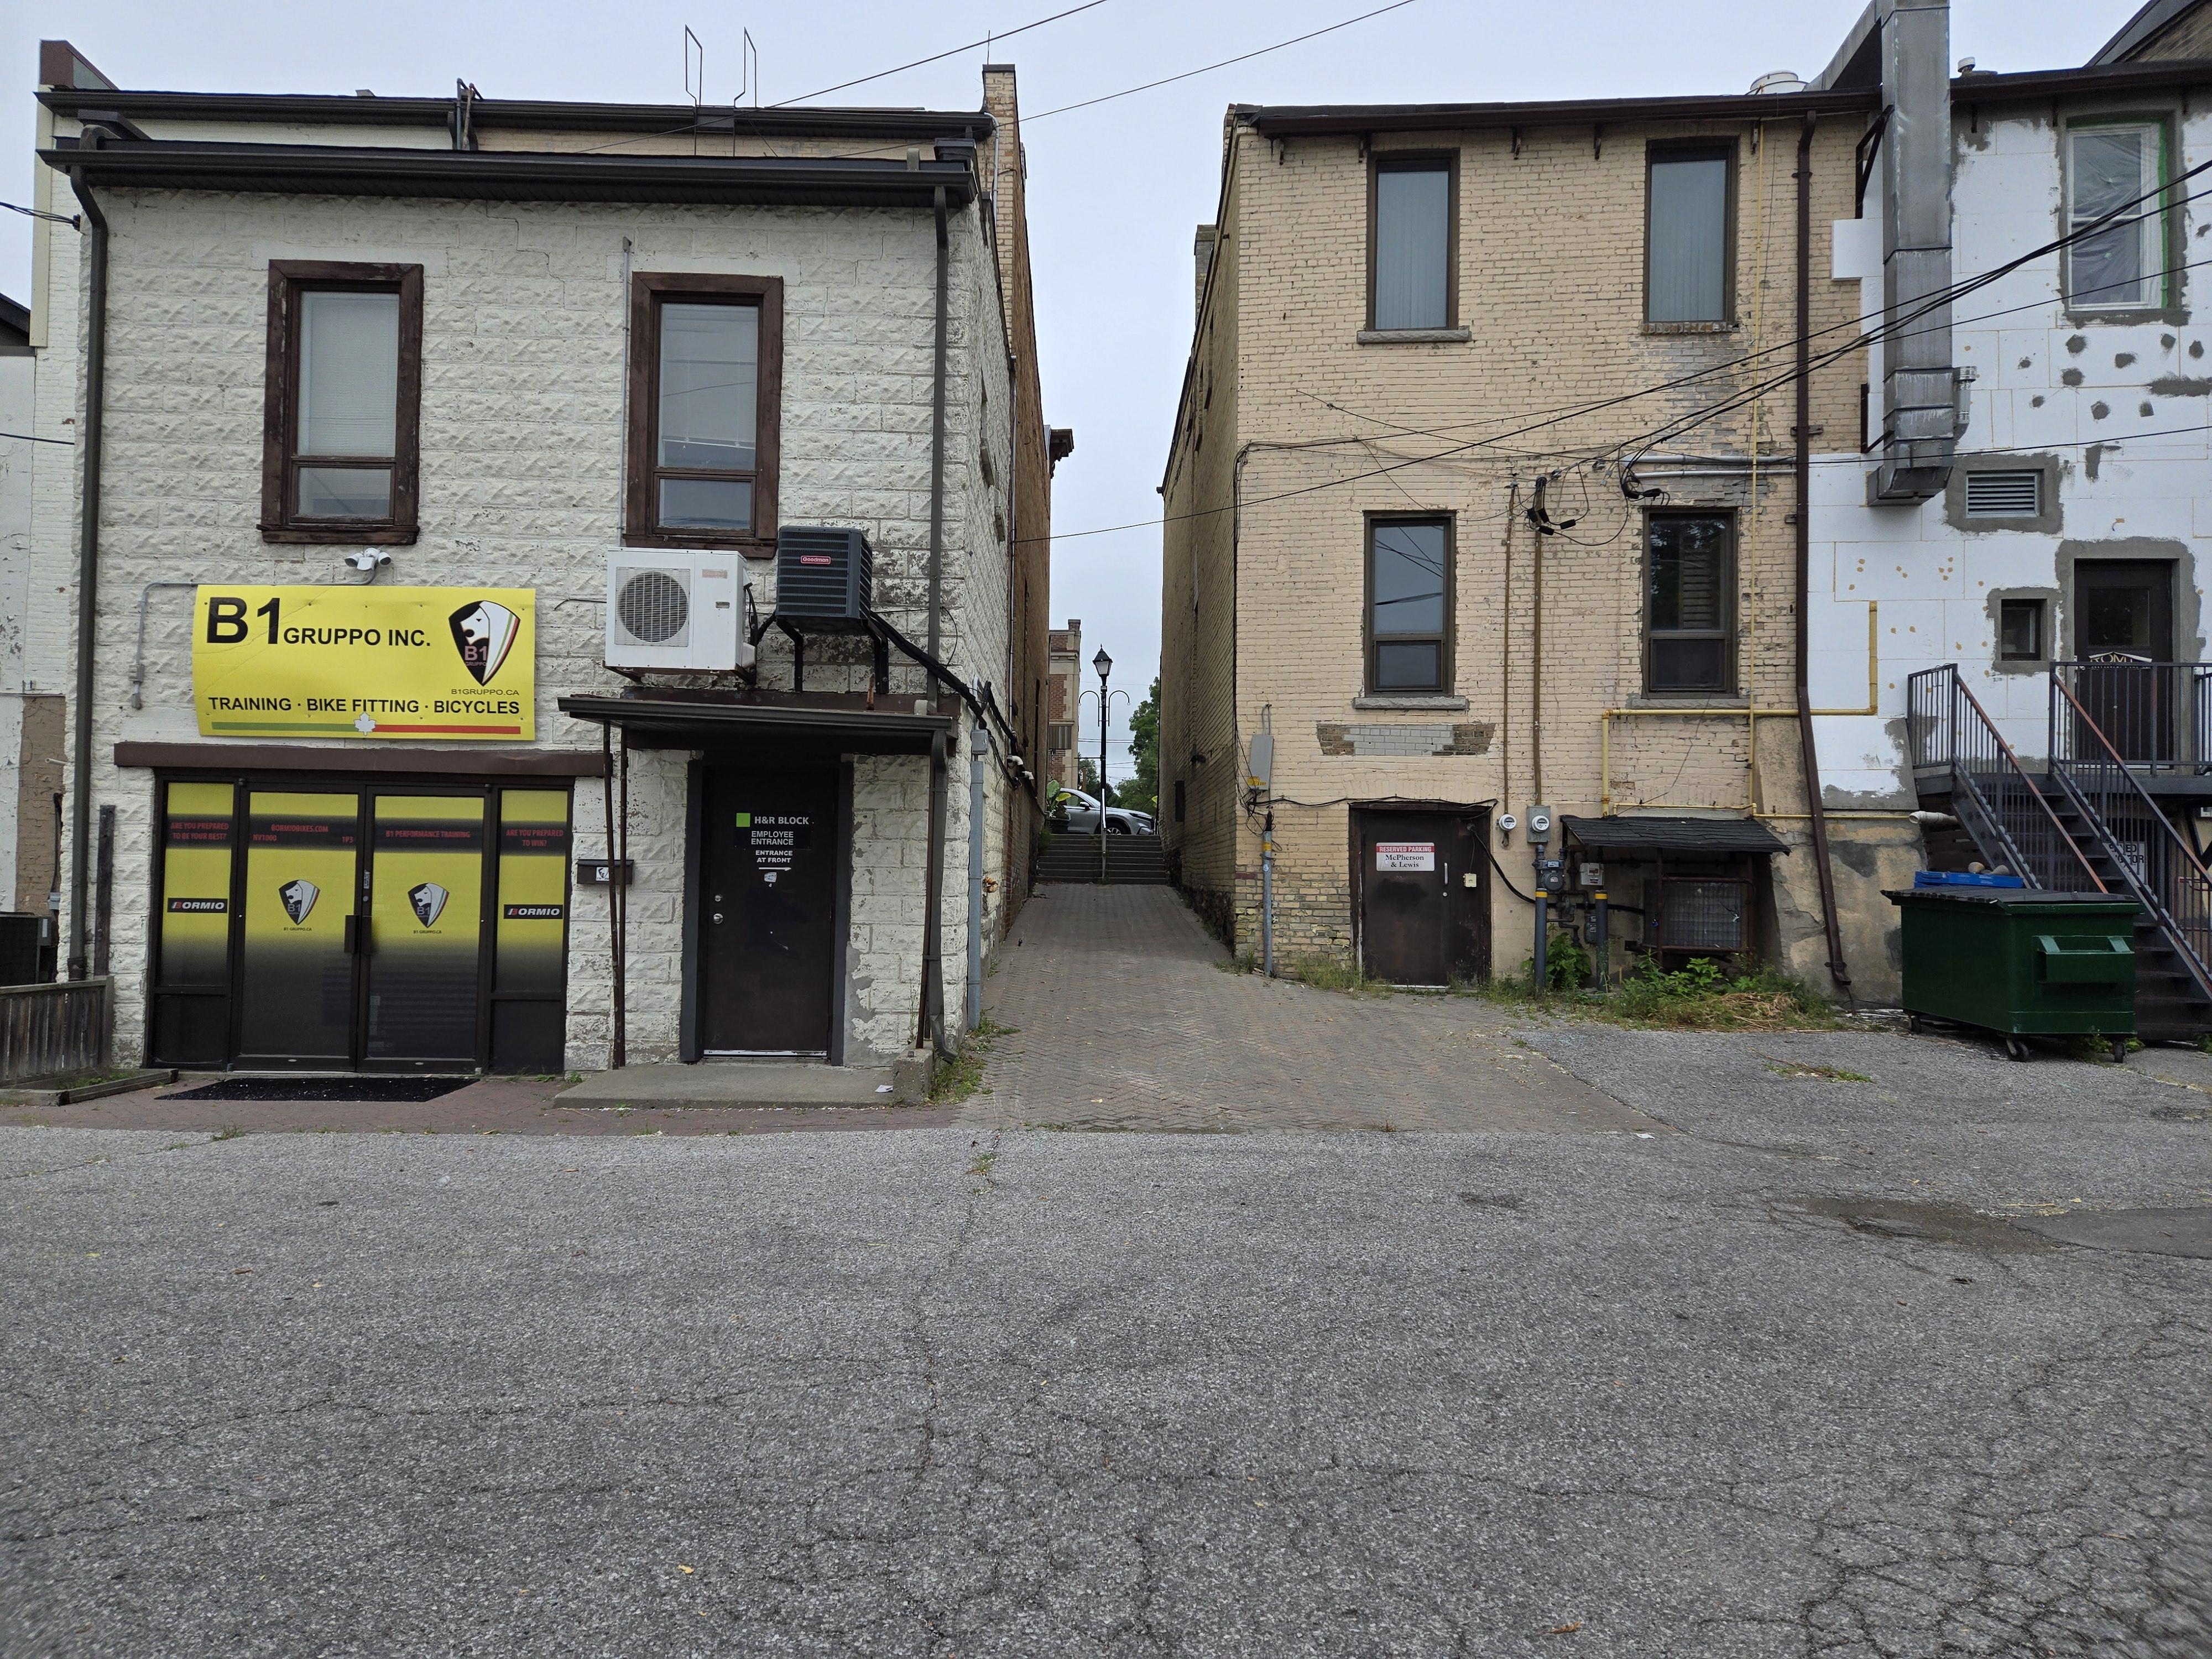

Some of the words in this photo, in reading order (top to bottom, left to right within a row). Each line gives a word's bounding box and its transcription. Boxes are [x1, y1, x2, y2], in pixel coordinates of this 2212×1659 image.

[206, 597, 280, 645] B1
[283, 627, 381, 645] GRUPPO
[388, 629, 431, 646] INC.
[465, 645, 487, 661] B1
[208, 697, 291, 711] TRAINING
[306, 698, 347, 712] BIKE
[352, 698, 419, 713] FITTING
[434, 700, 520, 714] BICYCLES
[754, 816, 775, 824] H&R
[197, 822, 229, 831] PREPARED
[288, 903, 301, 912] B1
[416, 906, 430, 915] B1
